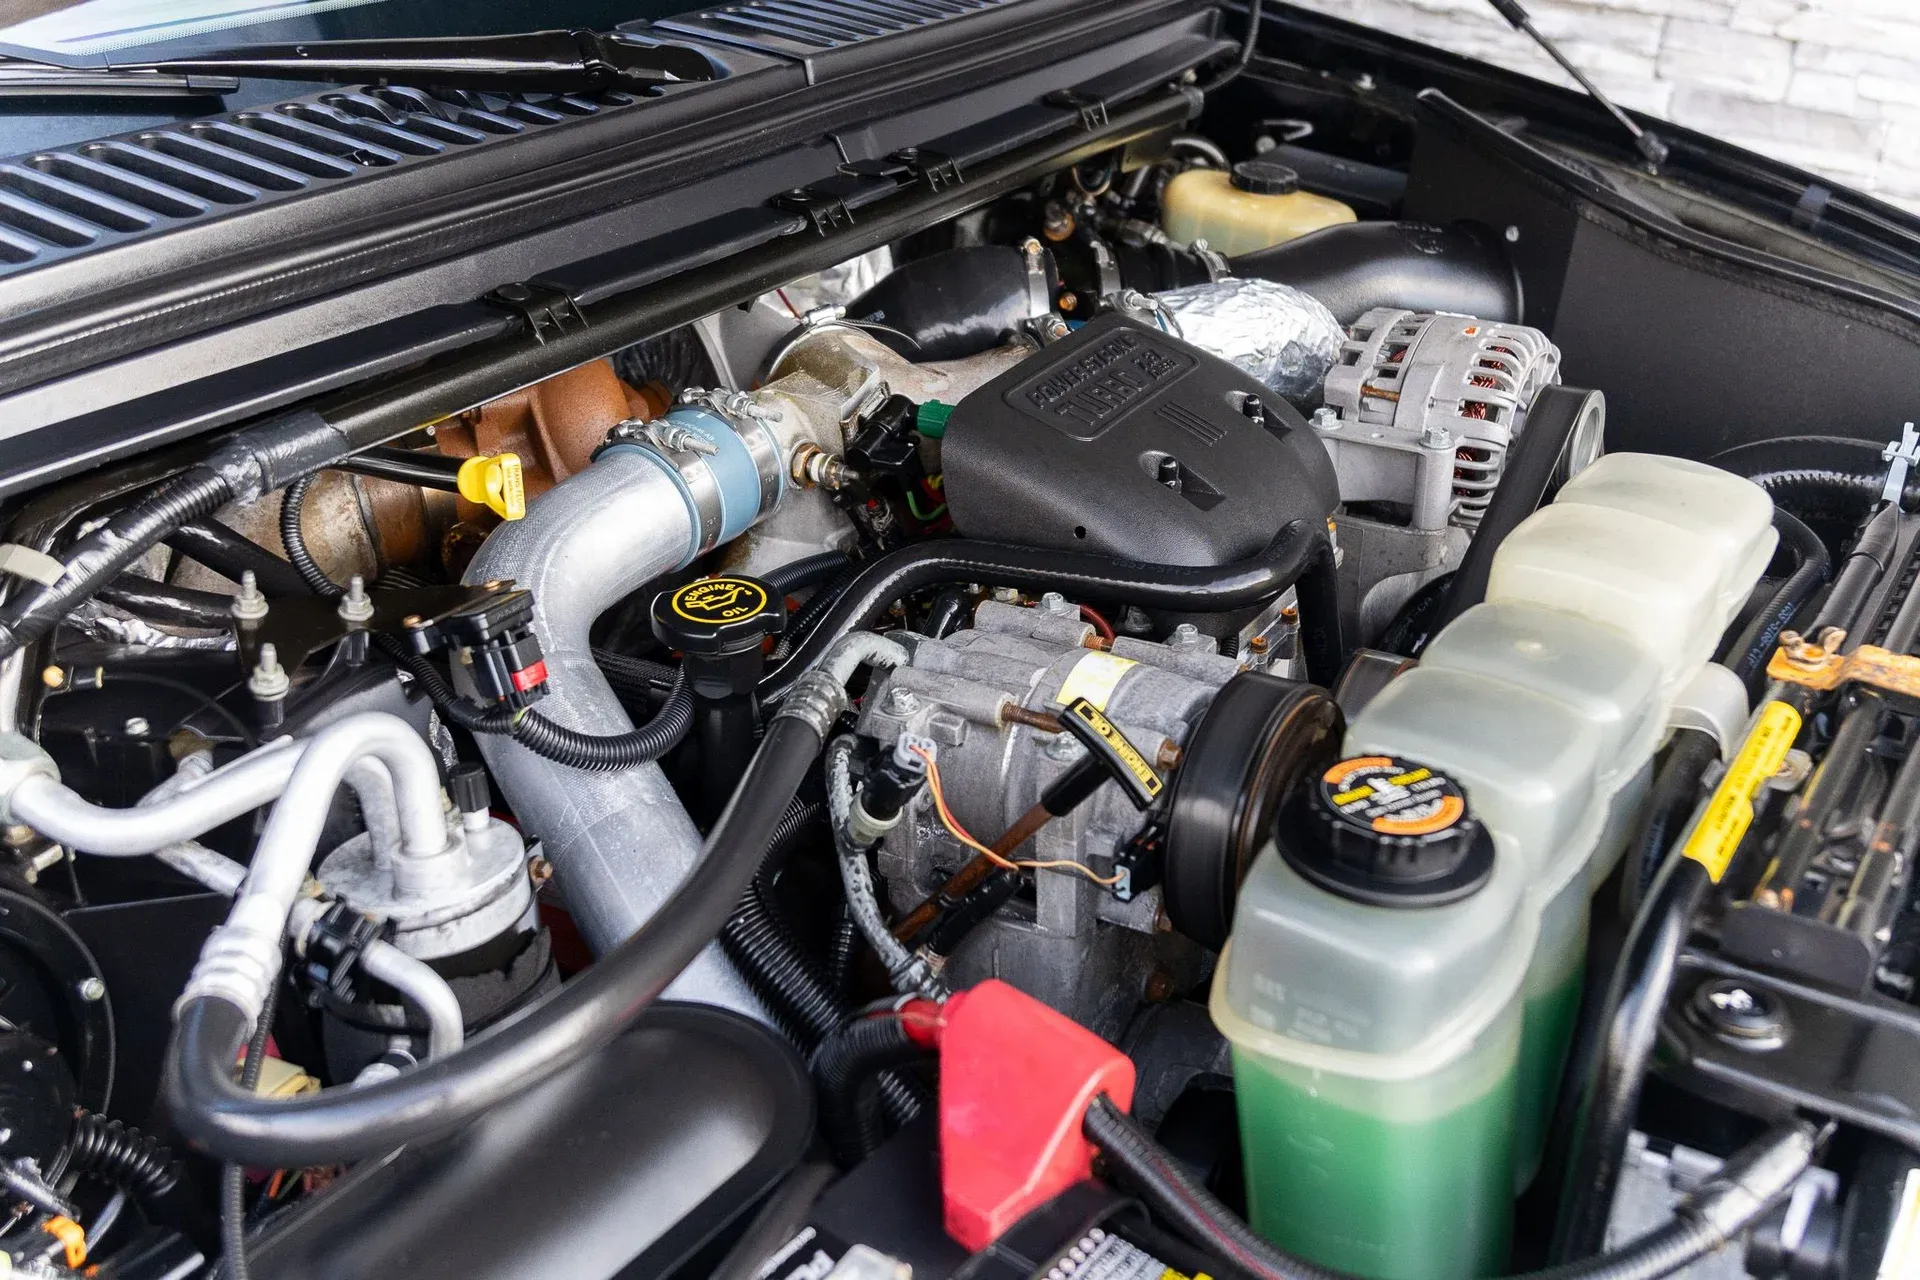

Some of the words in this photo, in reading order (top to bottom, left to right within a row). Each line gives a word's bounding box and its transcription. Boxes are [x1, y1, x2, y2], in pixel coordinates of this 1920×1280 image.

[1054, 369, 1150, 427] TURBO
[684, 583, 736, 601] ENGINE
[722, 606, 748, 617] OIL
